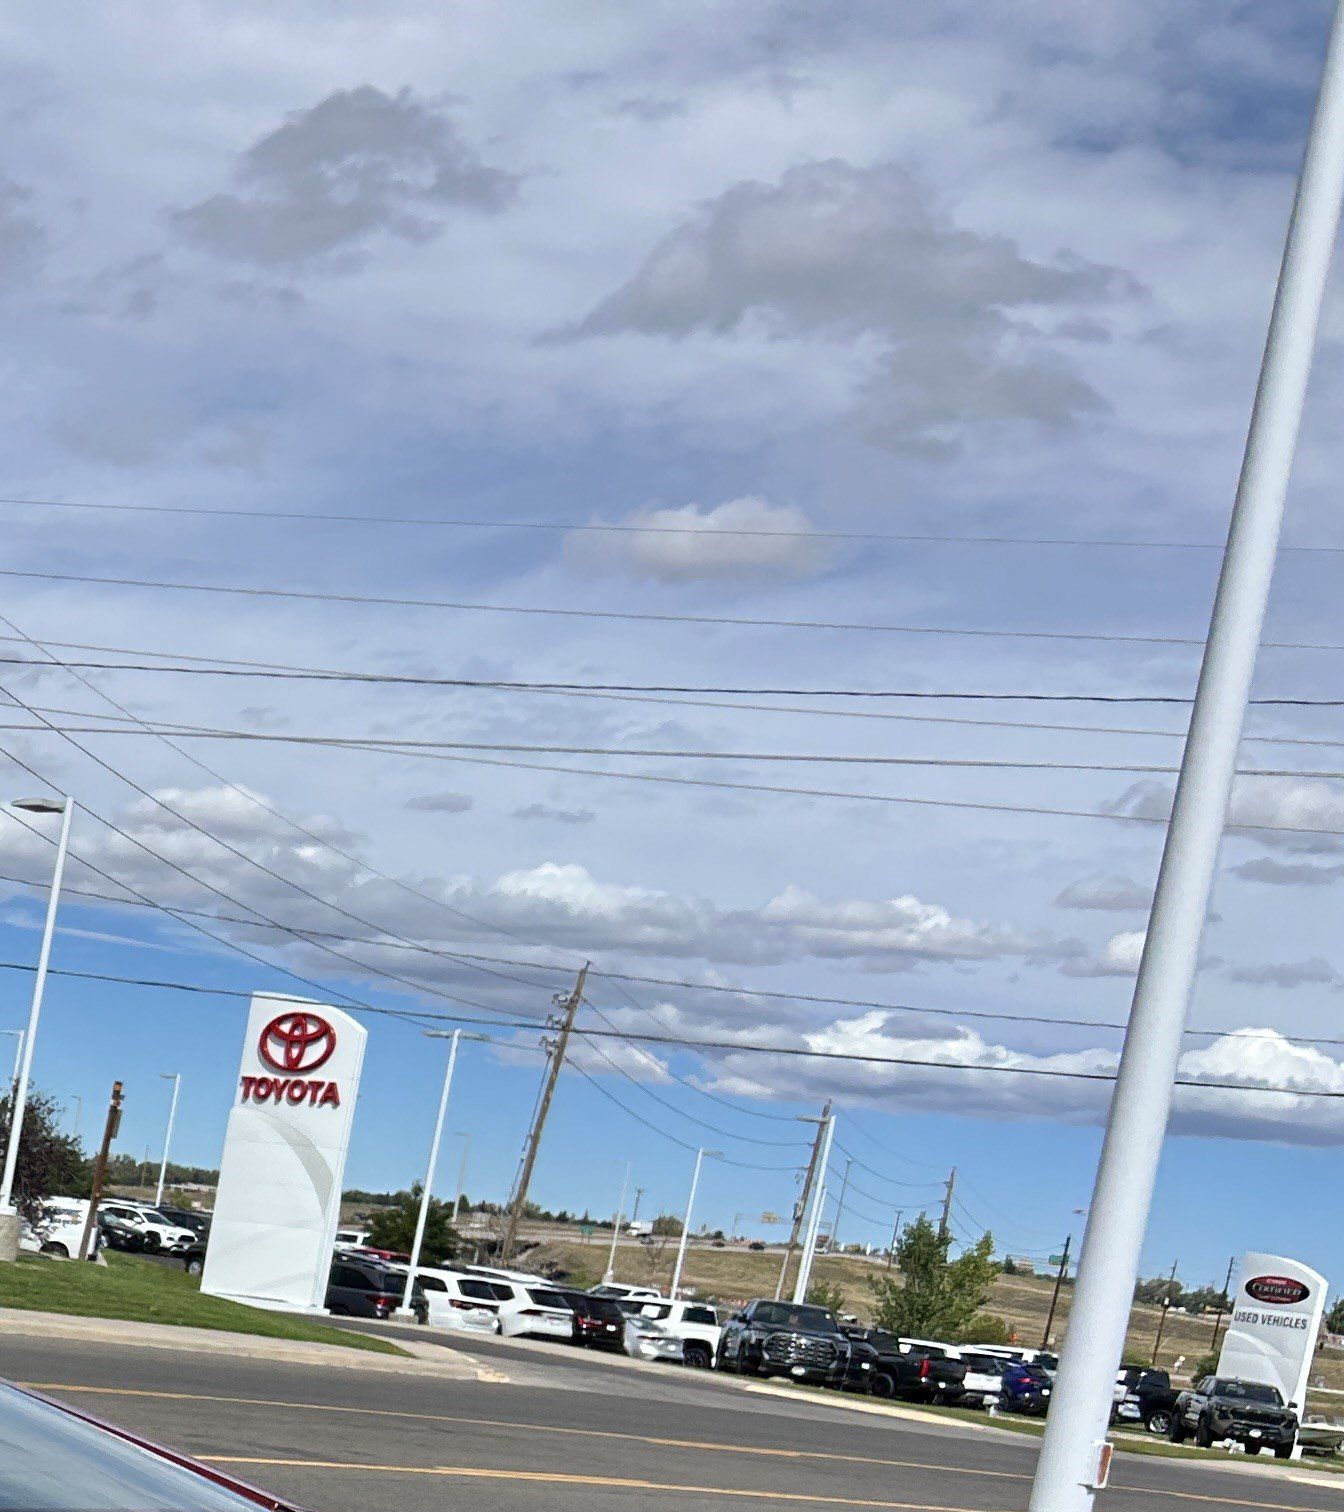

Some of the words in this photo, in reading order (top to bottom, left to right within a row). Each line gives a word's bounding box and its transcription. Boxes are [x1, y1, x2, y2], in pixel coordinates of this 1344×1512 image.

[240, 1076, 341, 1109] TOYOTA
[1234, 1310, 1259, 1324] USED
[1261, 1314, 1308, 1329] VEHICLES
